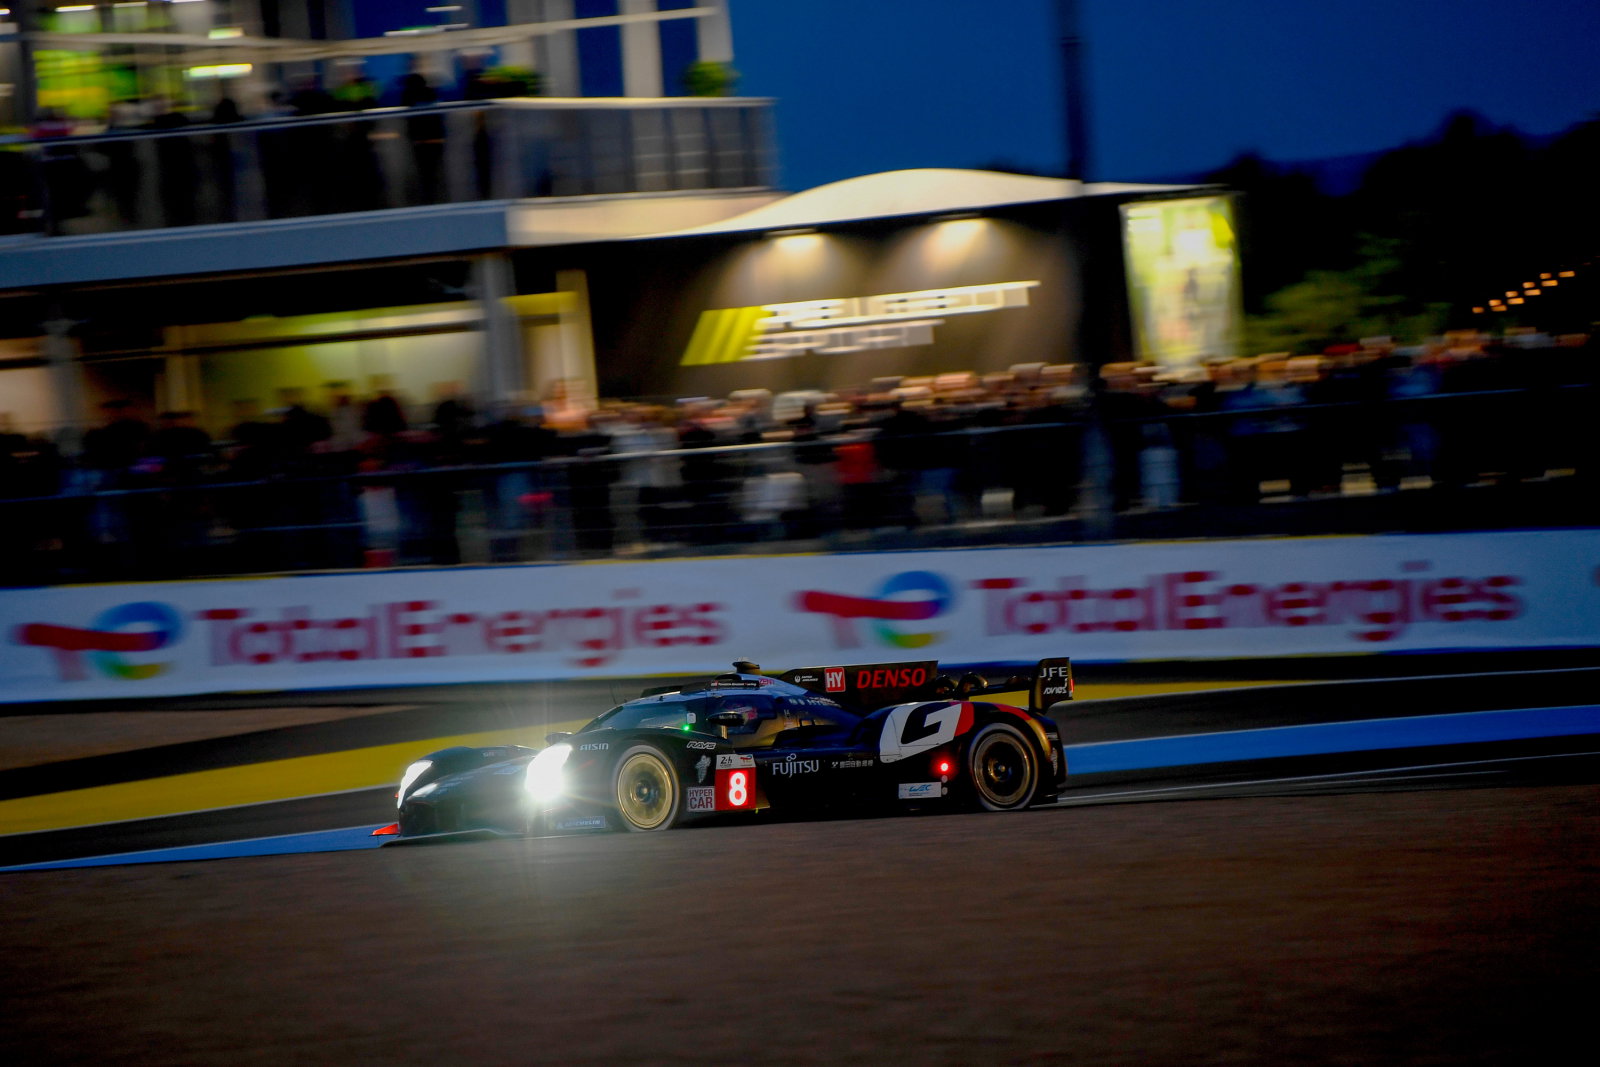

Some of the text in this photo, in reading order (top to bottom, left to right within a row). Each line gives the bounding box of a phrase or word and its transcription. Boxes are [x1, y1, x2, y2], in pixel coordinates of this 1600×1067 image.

[970, 561, 1526, 642] TotalEnergies
[197, 588, 729, 667] TotalEnergies
[826, 671, 844, 688] HY
[857, 668, 926, 689] DENSO
[1039, 666, 1068, 678] JFE
[579, 743, 609, 751] AISIN
[686, 741, 717, 750] RAYS
[772, 759, 819, 778] FUJITSU
[689, 788, 713, 797] HYPER
[729, 772, 747, 806] 8
[689, 797, 713, 809] CAR
